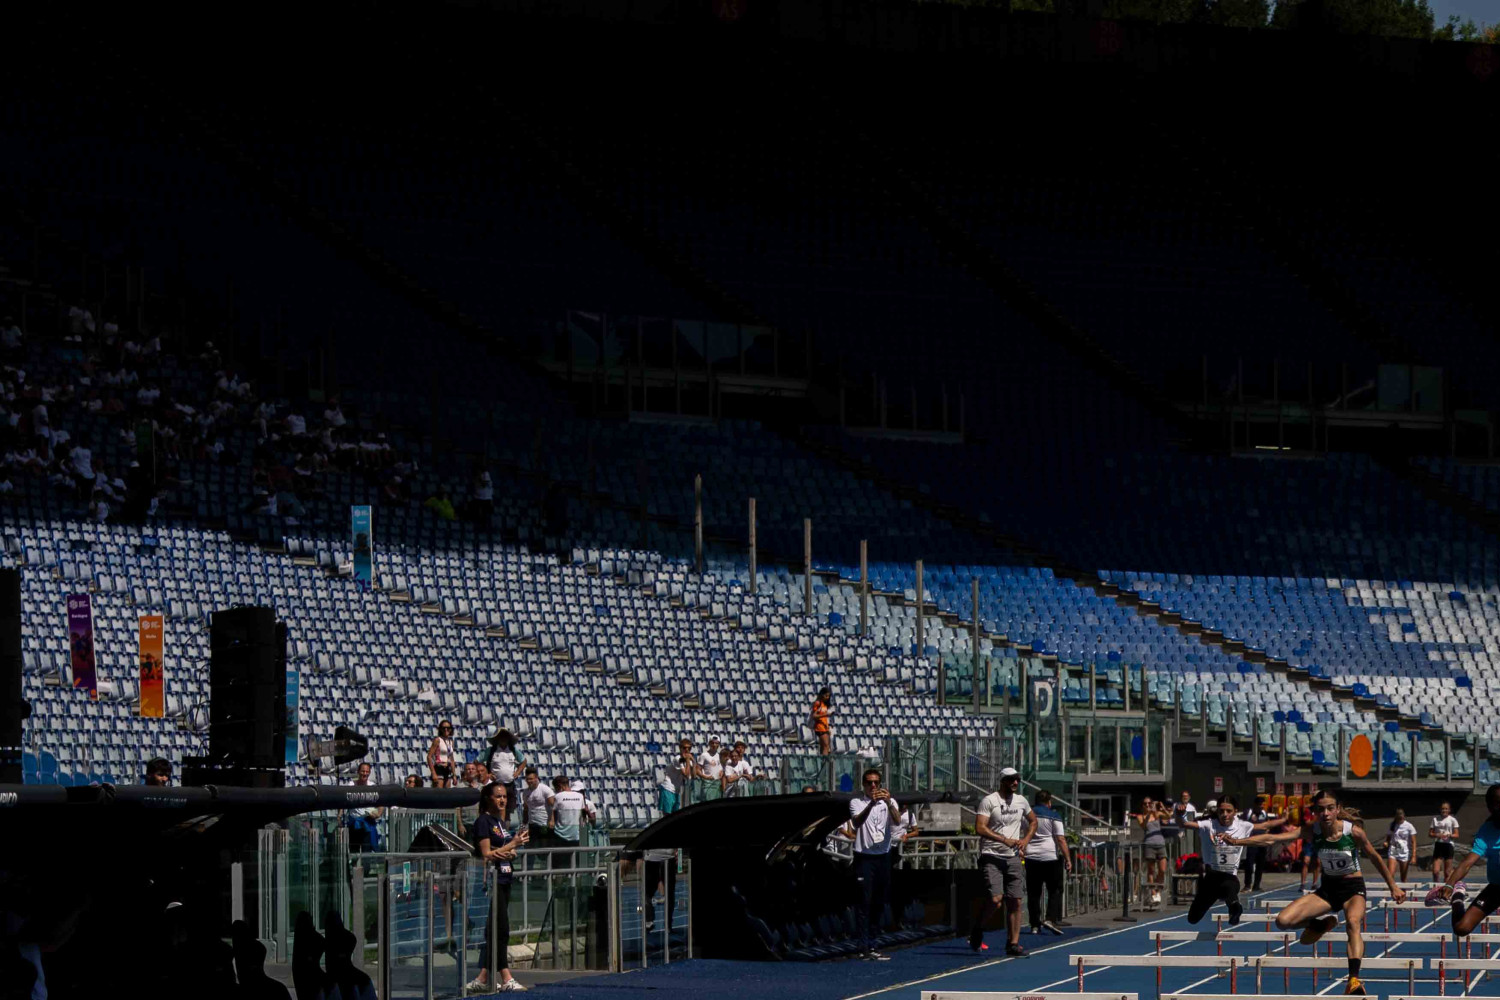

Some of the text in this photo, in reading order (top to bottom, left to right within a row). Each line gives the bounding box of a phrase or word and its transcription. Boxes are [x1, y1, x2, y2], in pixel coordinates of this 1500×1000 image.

[1034, 681, 1054, 717] D
[1219, 853, 1228, 865] 3
[1328, 859, 1347, 870] 10
